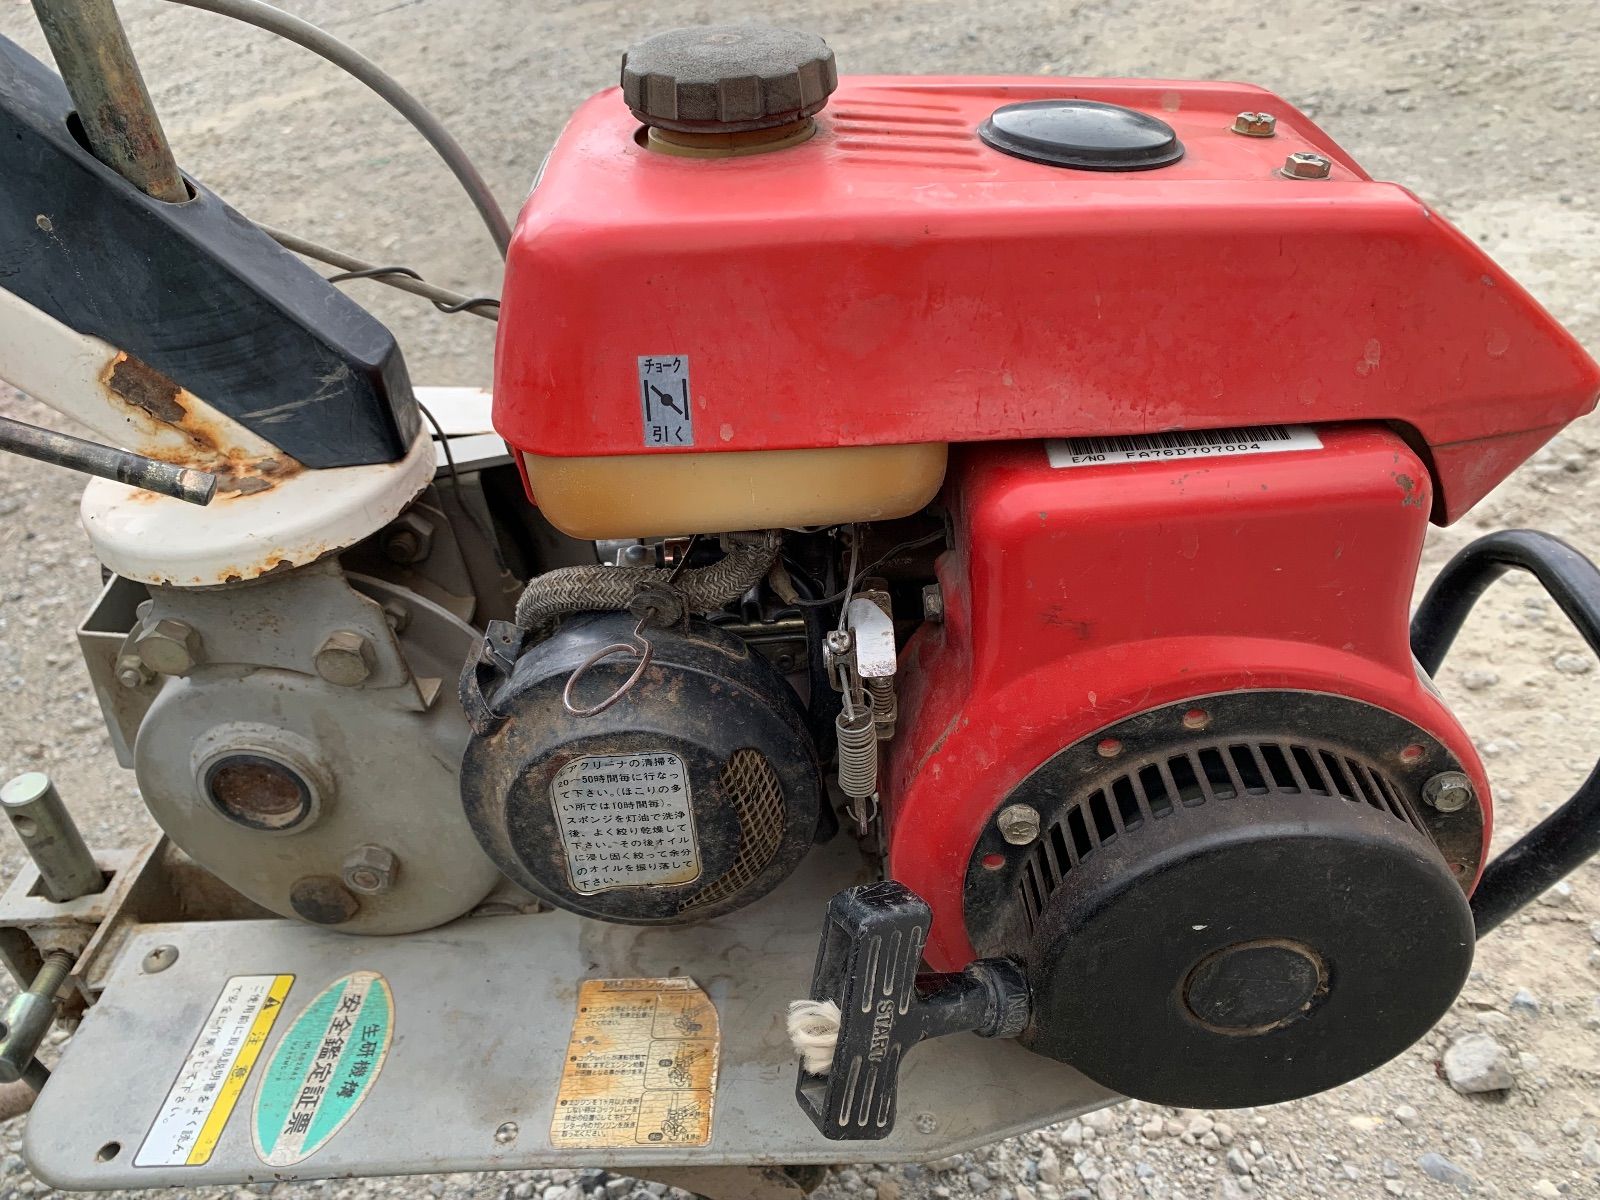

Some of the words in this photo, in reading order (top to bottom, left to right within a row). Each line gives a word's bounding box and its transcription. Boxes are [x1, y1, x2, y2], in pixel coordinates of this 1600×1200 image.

[644, 357, 681, 374] チョーク
[652, 425, 683, 442] 引く
[1072, 454, 1105, 463] E/NO
[1126, 443, 1261, 459] FA76D707004
[566, 811, 686, 824] スポンジを灯油で洗浄
[568, 824, 687, 838] 後、よく絞り乾燥して
[574, 849, 692, 862] に浸し固く絞って余分
[577, 860, 692, 876] のオイルを振り落して
[580, 877, 620, 889] 下さい。
[868, 1000, 894, 1062] START
[284, 993, 362, 1135] 安全鑑定証票
[336, 1023, 381, 1099] 生研機構
